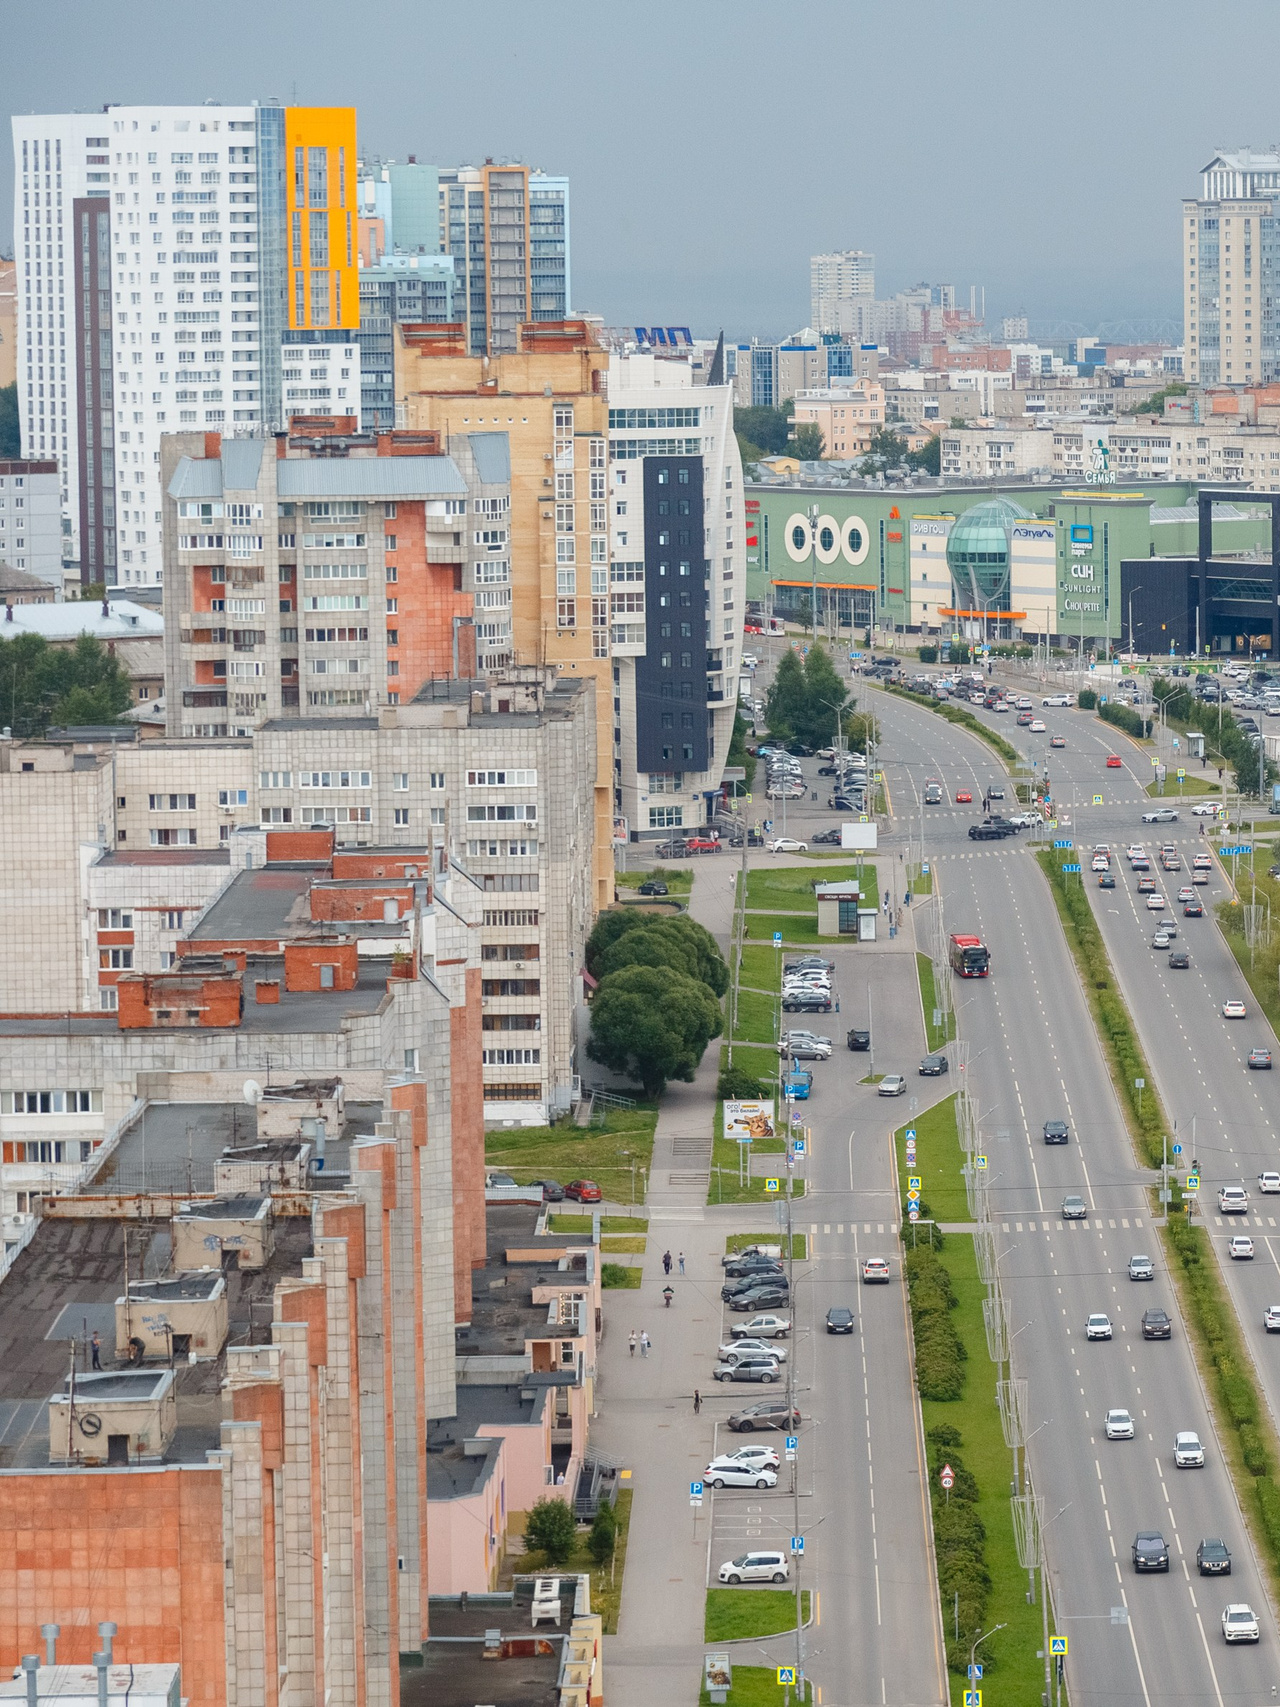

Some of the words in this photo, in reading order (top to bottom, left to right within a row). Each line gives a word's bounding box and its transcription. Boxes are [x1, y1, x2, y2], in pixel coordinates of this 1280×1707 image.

[914, 523, 928, 532] РИВ
[928, 525, 945, 534] ГОШ
[1064, 583, 1101, 594] SUNLIGHT
